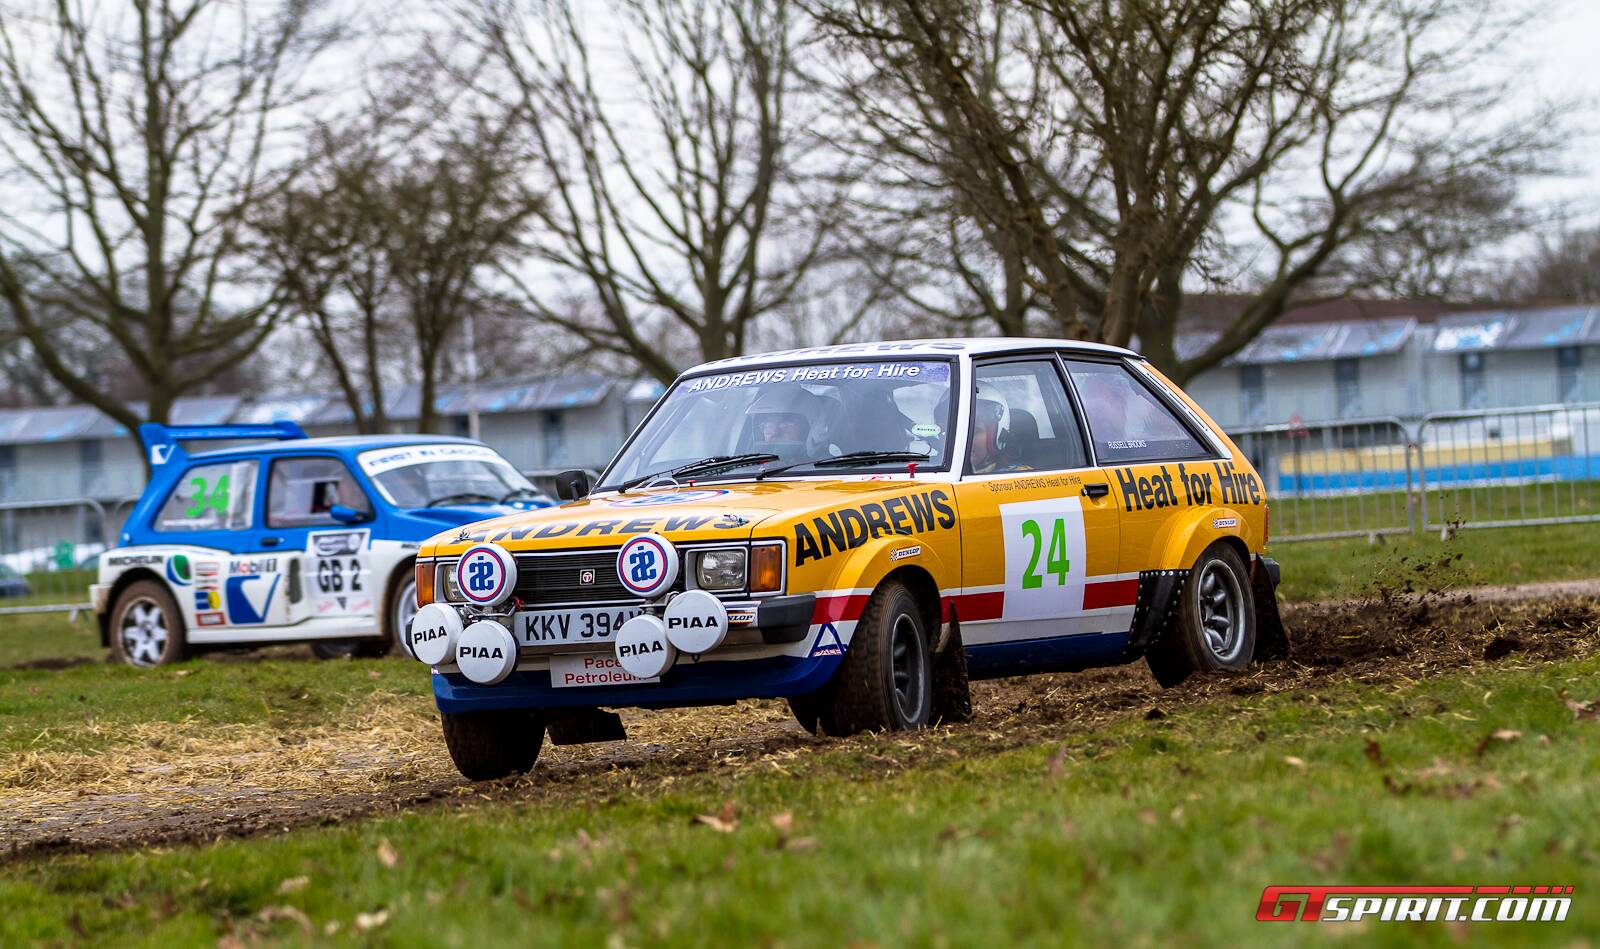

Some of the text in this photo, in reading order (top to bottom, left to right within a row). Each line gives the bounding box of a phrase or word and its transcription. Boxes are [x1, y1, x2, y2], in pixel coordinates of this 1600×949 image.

[688, 363, 921, 393] ANDREWS Heat for Hire
[1107, 439, 1147, 450] RUSSELL BROOKS
[988, 474, 1082, 493] Sponsor ANDREWS Heat for Hire
[1115, 462, 1261, 513] Heat for Hire
[185, 474, 230, 518] 34
[449, 514, 755, 545] ANDREWS
[794, 489, 955, 568] ANDREWS
[108, 555, 164, 566] MICHELIN
[898, 547, 920, 558] DUNLOP
[1021, 518, 1070, 590] 24
[229, 560, 265, 573] Mobil
[318, 559, 362, 593] GB 2
[525, 614, 571, 641] KKV
[668, 615, 719, 629] PIAA
[727, 613, 755, 623] NLOP
[413, 625, 448, 645] PIAA
[460, 646, 504, 659] PIAA
[619, 640, 664, 658] PIAA
